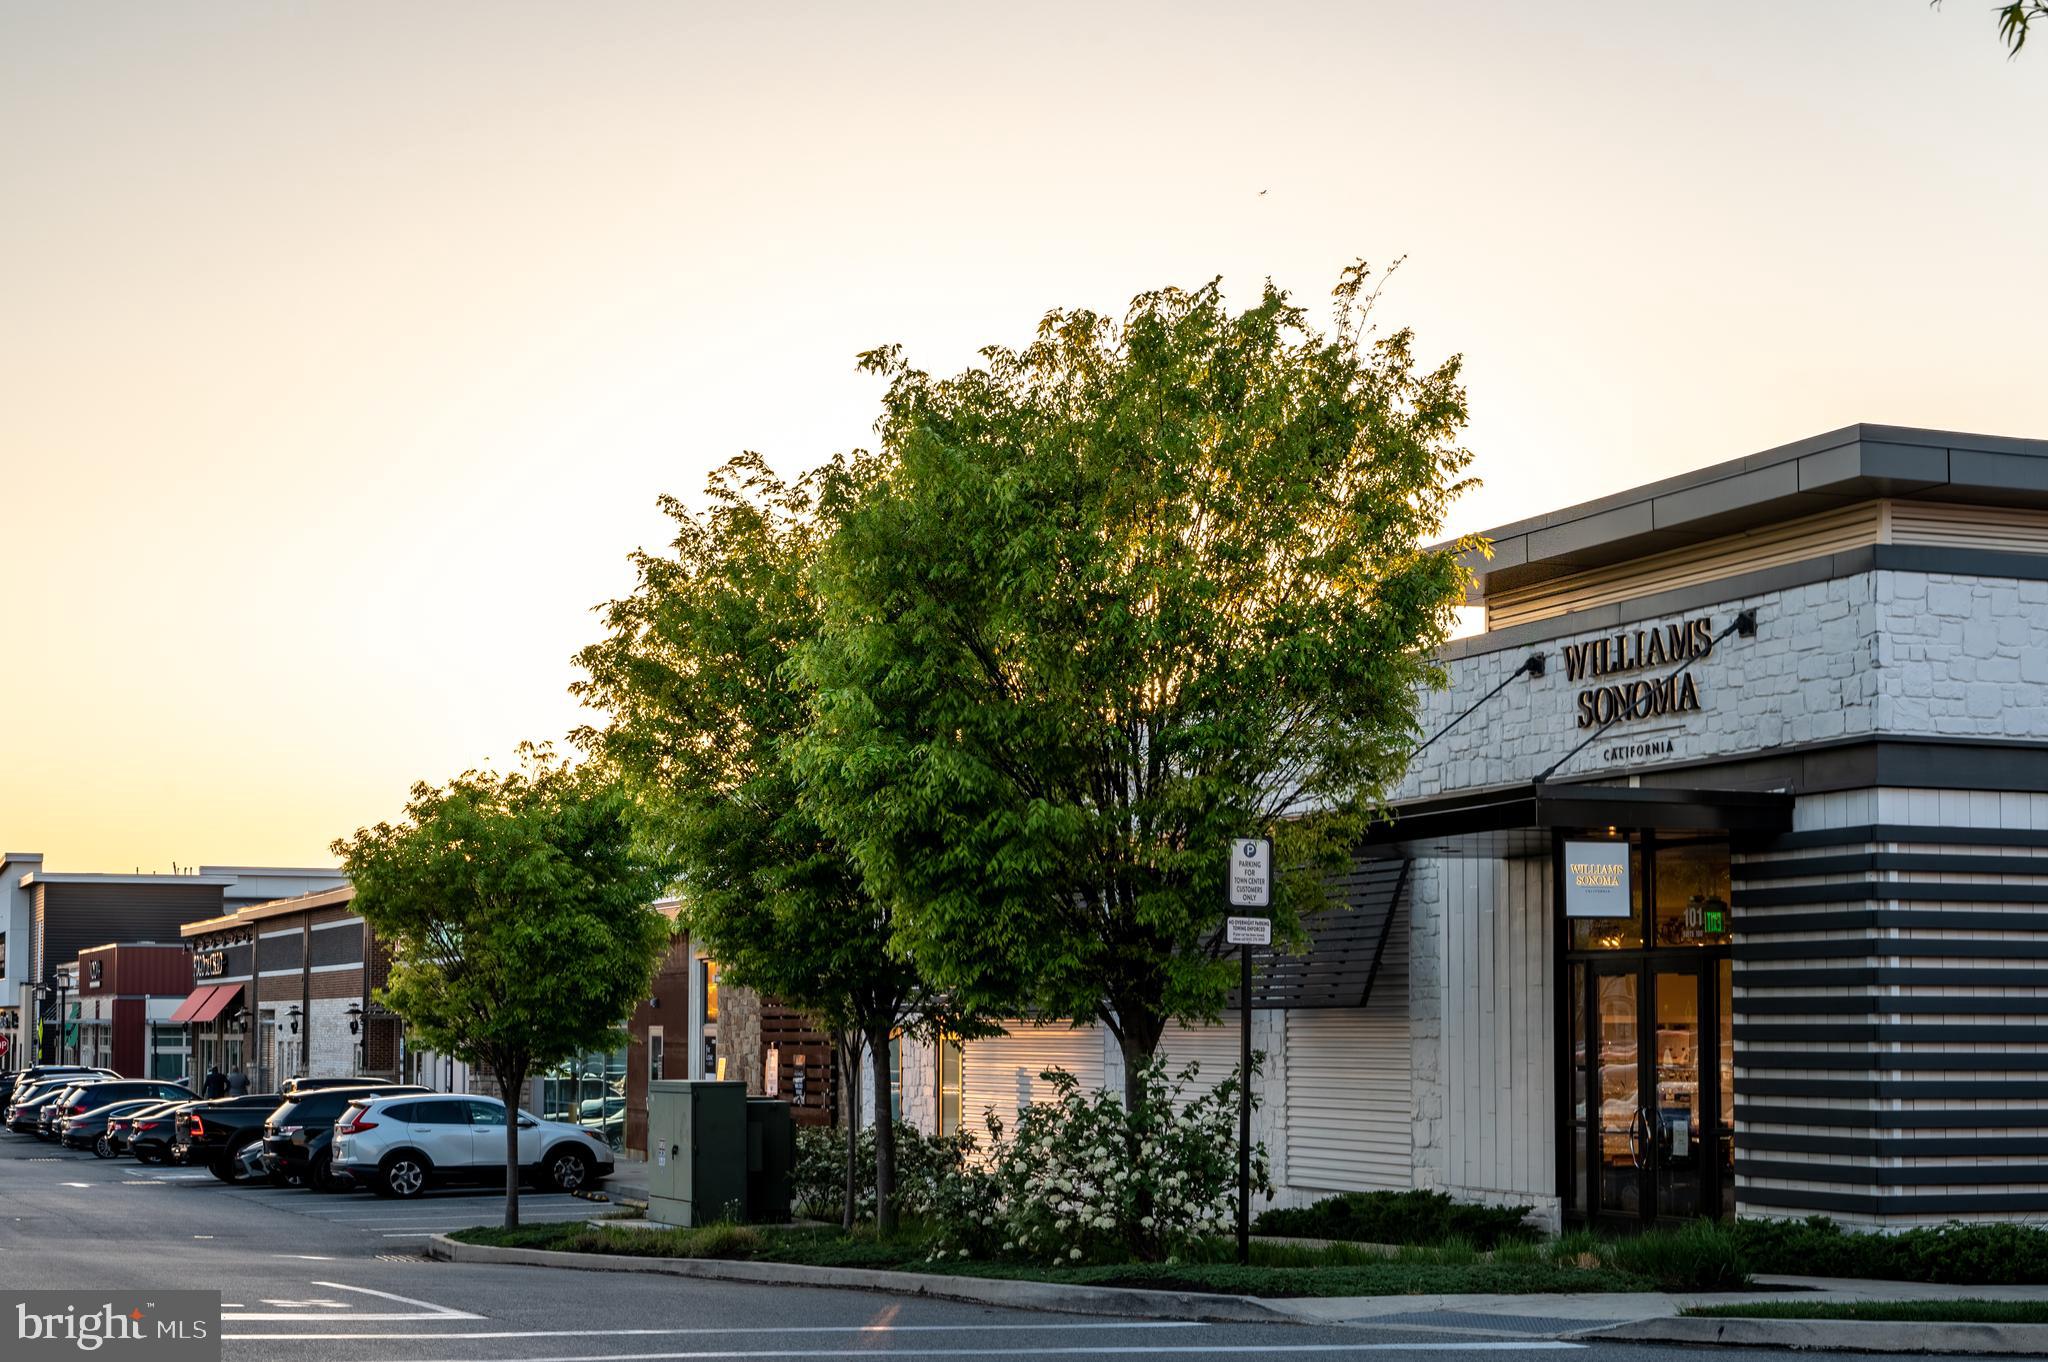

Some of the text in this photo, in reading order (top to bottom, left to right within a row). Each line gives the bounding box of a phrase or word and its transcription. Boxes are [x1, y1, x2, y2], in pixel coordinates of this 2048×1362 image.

[1561, 617, 1713, 682] WILLIAMS
[1577, 672, 1701, 729] SONOMA
[1603, 740, 1674, 761] CALIFORNIA
[1570, 863, 1624, 875] WILLIAMS
[1236, 886, 1262, 894] CUSTOMERS
[1576, 875, 1619, 886] SONOMA
[1683, 907, 1703, 928] 101
